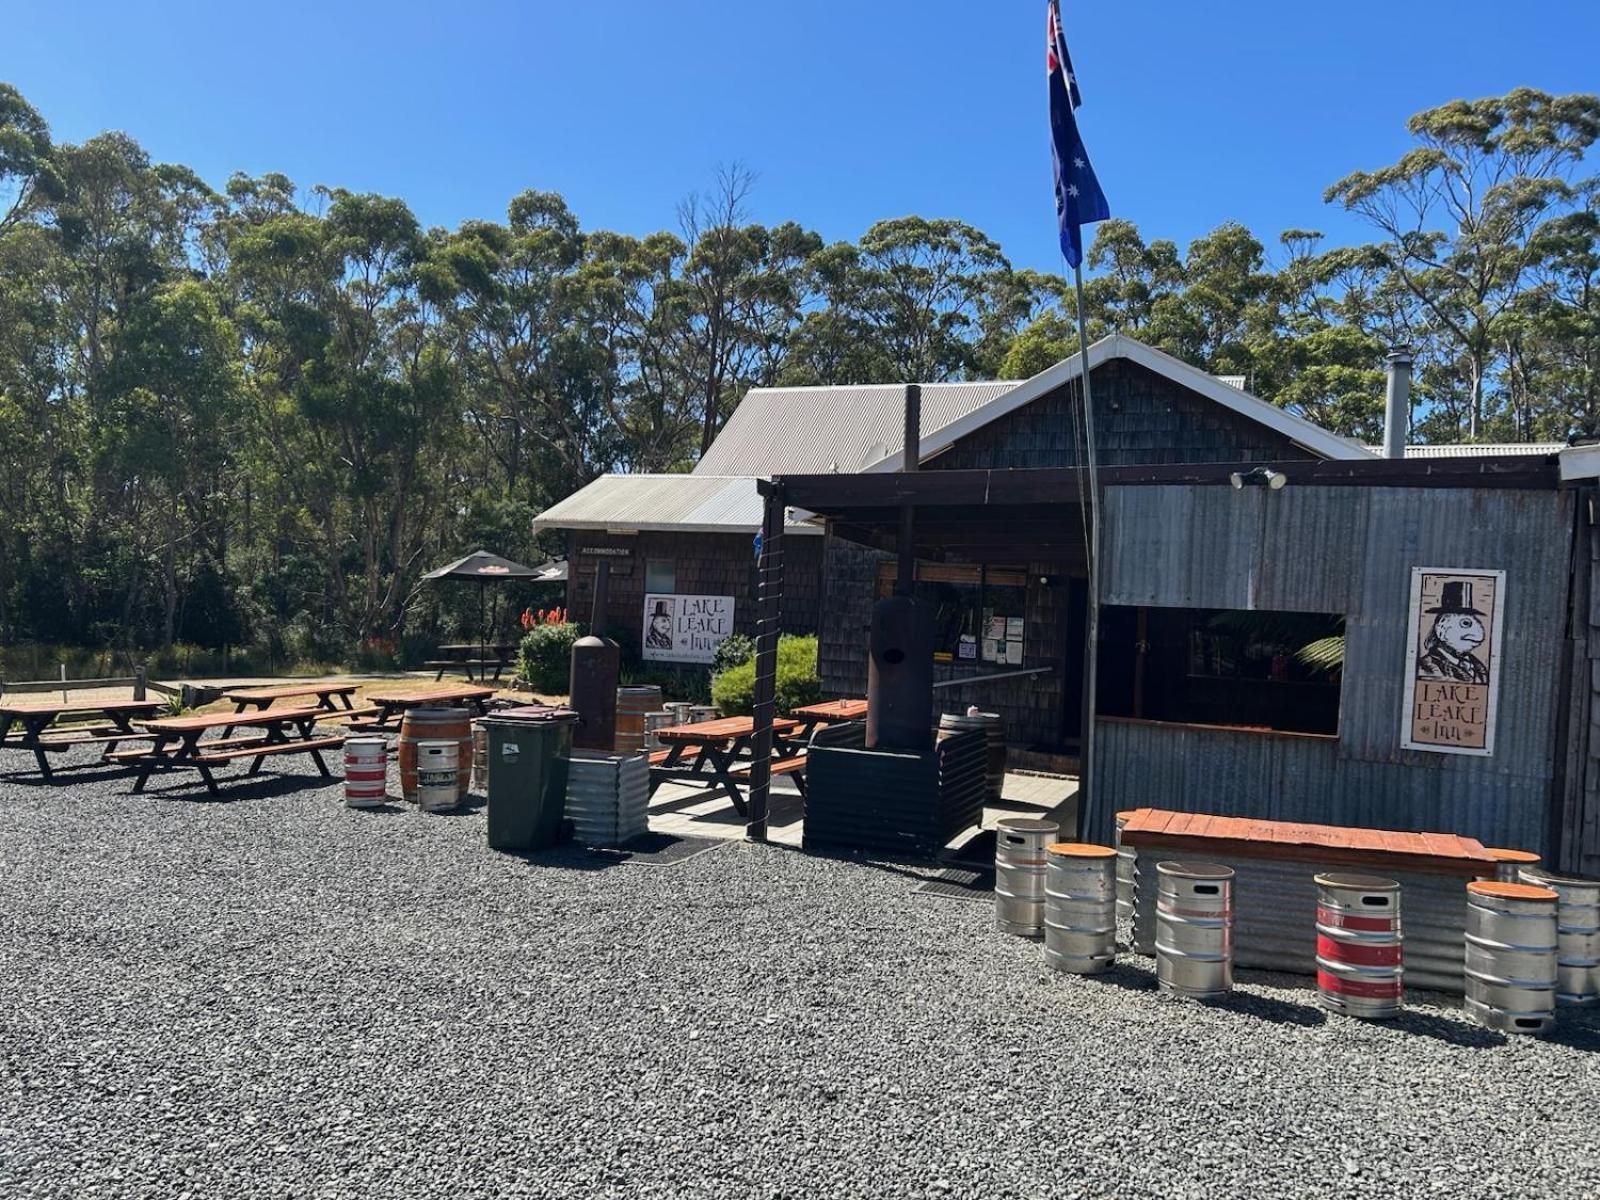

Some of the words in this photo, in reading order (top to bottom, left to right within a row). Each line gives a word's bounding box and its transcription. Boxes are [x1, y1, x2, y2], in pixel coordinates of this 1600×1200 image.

[682, 599, 725, 616] LAKE
[678, 617, 728, 635] LEAKE
[690, 633, 711, 650] Inn
[1423, 684, 1479, 704] LAKE
[1416, 703, 1483, 725] LEAKE
[1434, 721, 1461, 741] Inn
